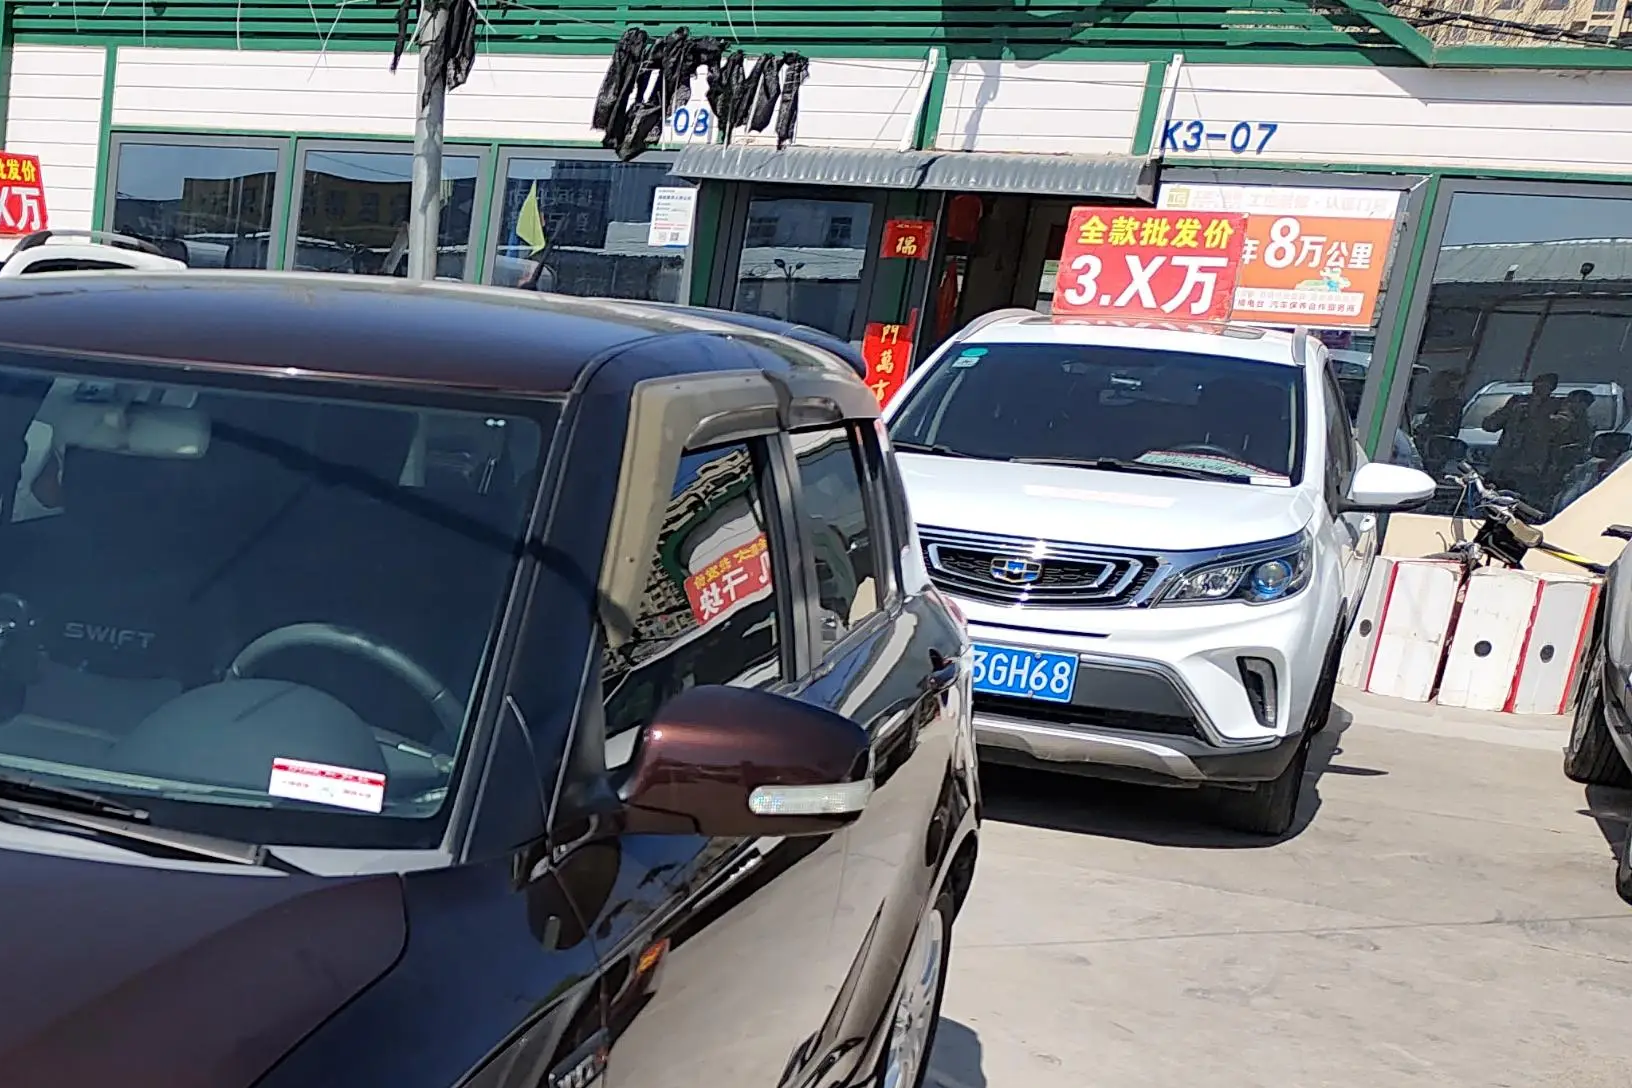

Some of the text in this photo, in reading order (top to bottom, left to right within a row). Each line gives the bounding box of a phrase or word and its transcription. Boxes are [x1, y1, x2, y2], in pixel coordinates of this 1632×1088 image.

[1160, 120, 1278, 155] K3-07
[1077, 215, 1235, 249] 全款批发价
[1064, 254, 1228, 315] 3.X万
[63, 621, 156, 649] SWIFT
